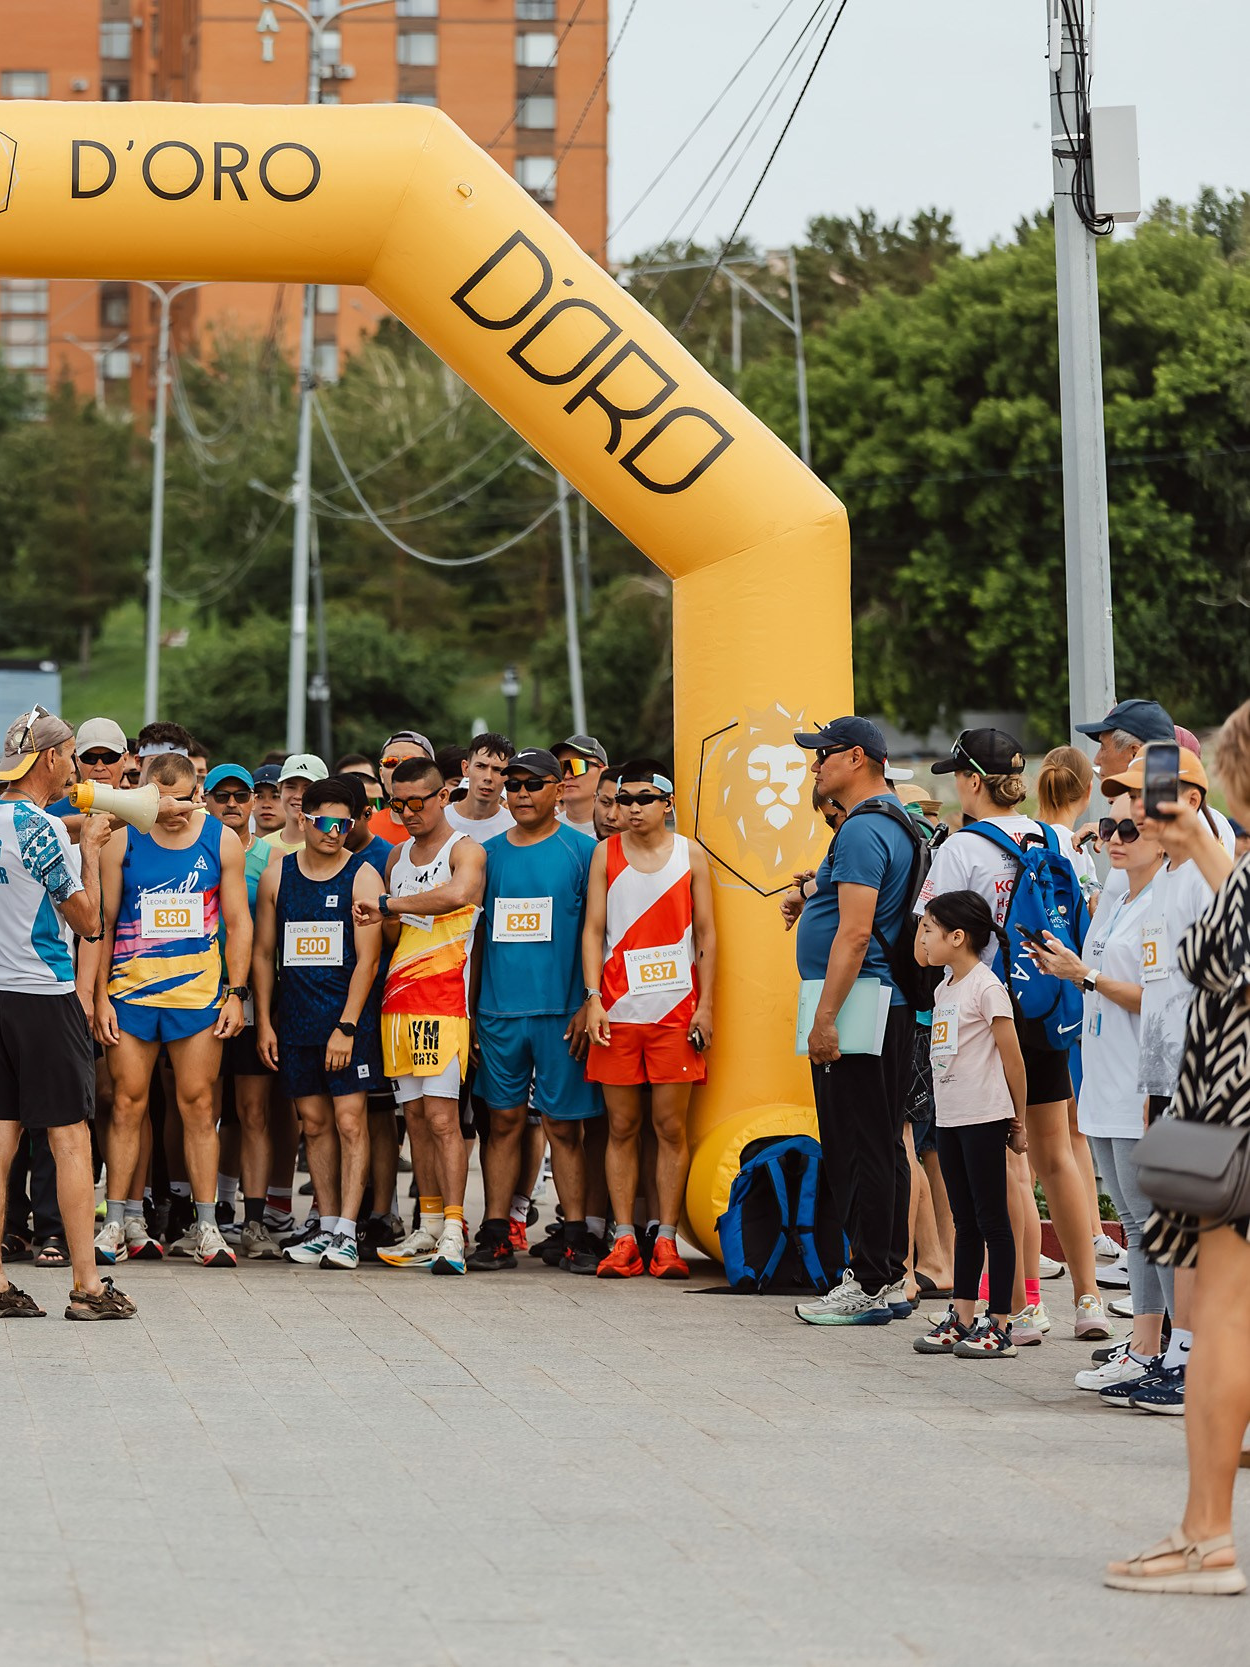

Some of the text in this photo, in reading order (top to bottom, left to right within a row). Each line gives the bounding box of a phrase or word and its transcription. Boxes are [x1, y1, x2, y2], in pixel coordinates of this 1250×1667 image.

[71, 139, 321, 202] D'ORO
[450, 229, 735, 494] D'ORO
[158, 911, 187, 925] 360
[510, 915, 537, 929] 343
[299, 939, 327, 953] 500
[630, 954, 652, 962] LEONE
[643, 963, 672, 980] 337
[408, 1020, 440, 1050] YM
